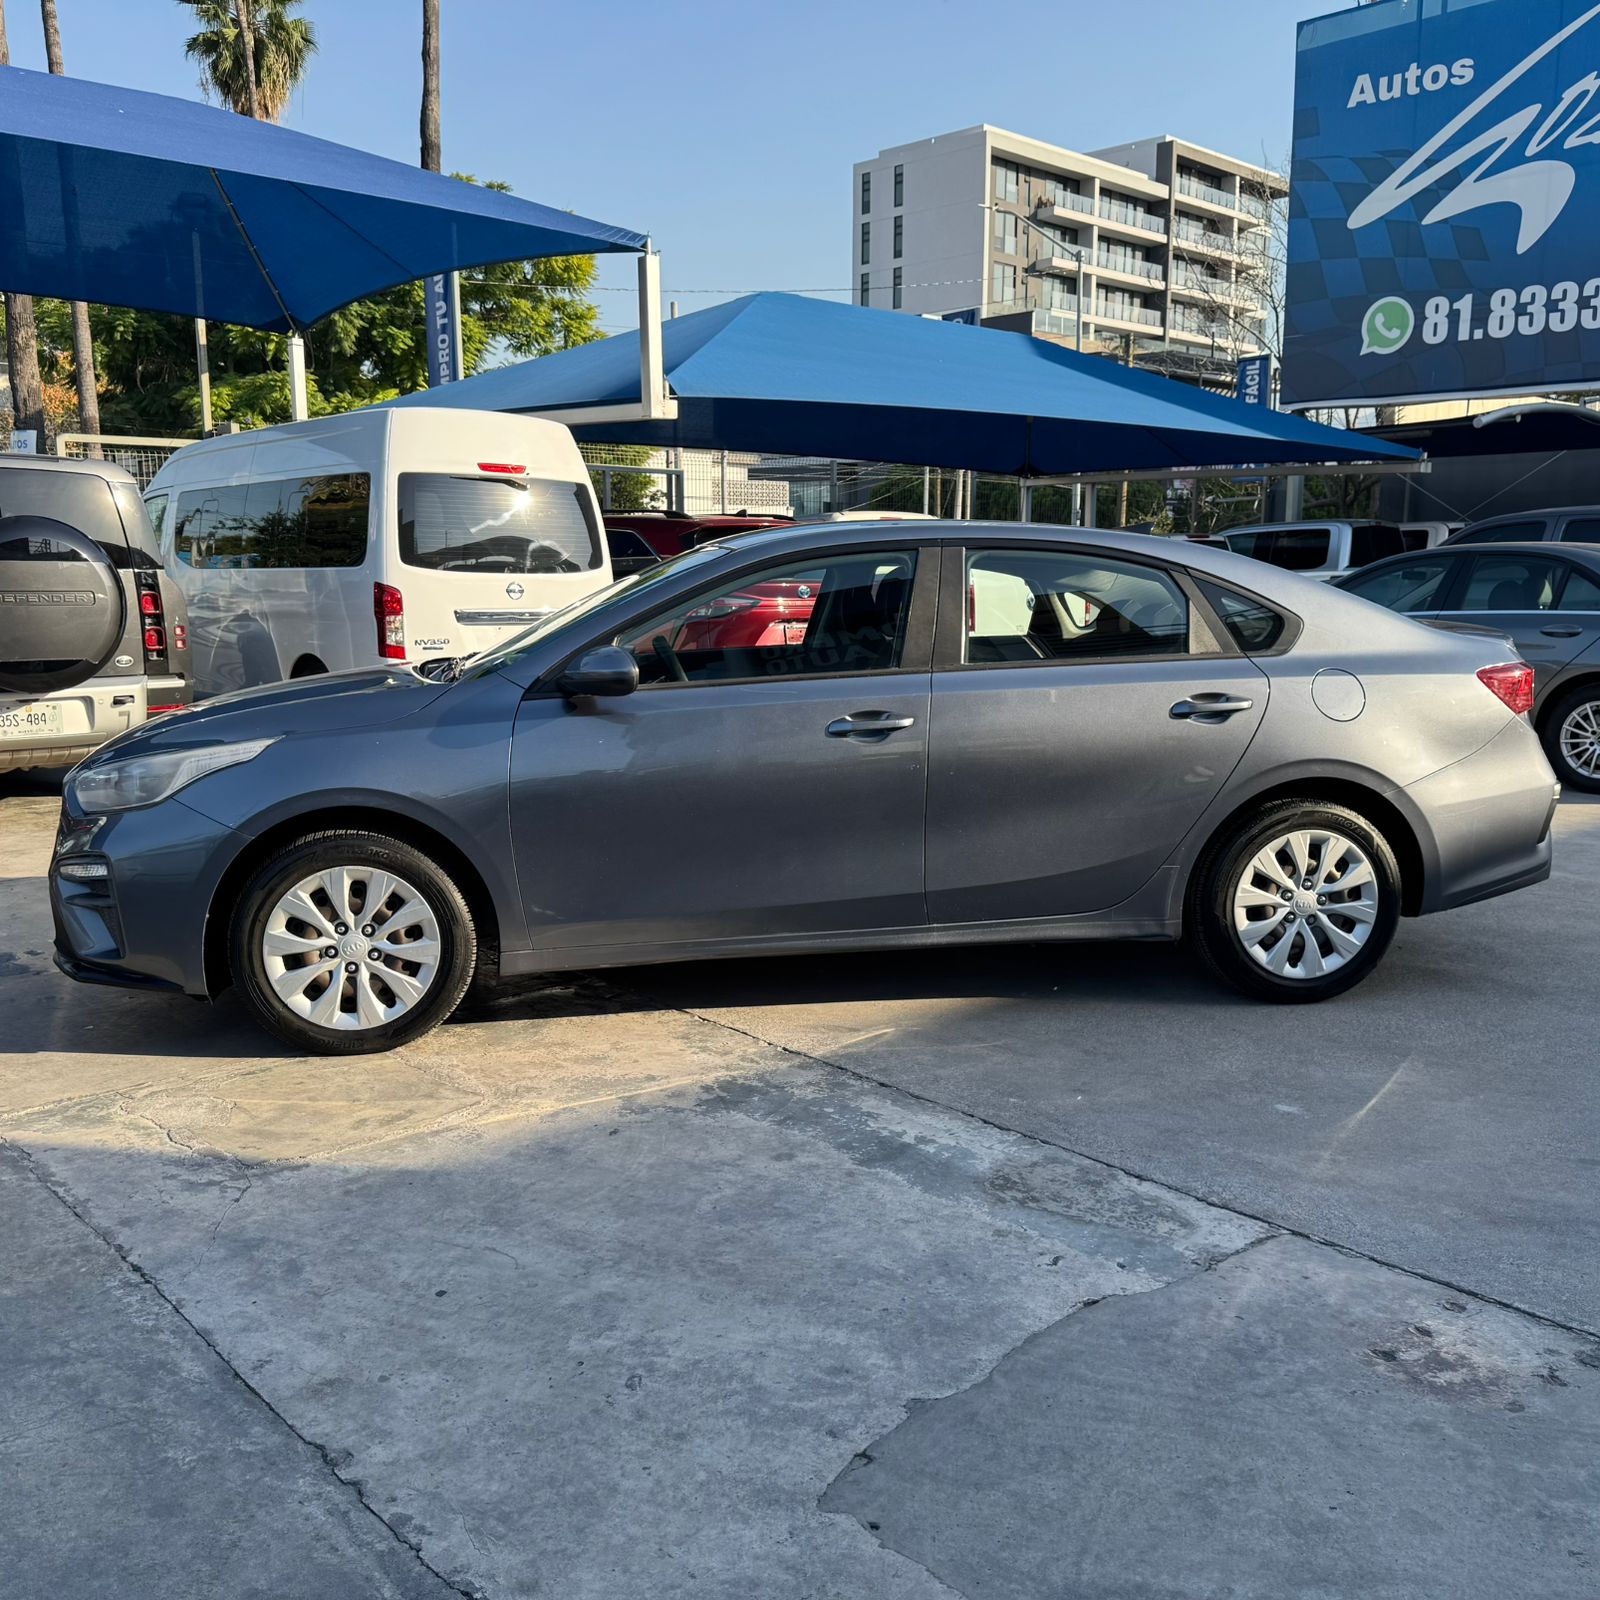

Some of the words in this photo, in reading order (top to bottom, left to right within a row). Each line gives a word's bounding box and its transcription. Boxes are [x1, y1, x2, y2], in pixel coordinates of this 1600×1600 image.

[1346, 57, 1475, 109] Autos
[435, 300, 448, 329] TU
[1422, 276, 1600, 345] 81.8333
[1242, 360, 1260, 404] FÁCIL
[0, 593, 92, 603] EFENDER
[414, 638, 450, 646] NV350
[1296, 900, 1311, 909] KIA
[344, 941, 364, 955] KIA
